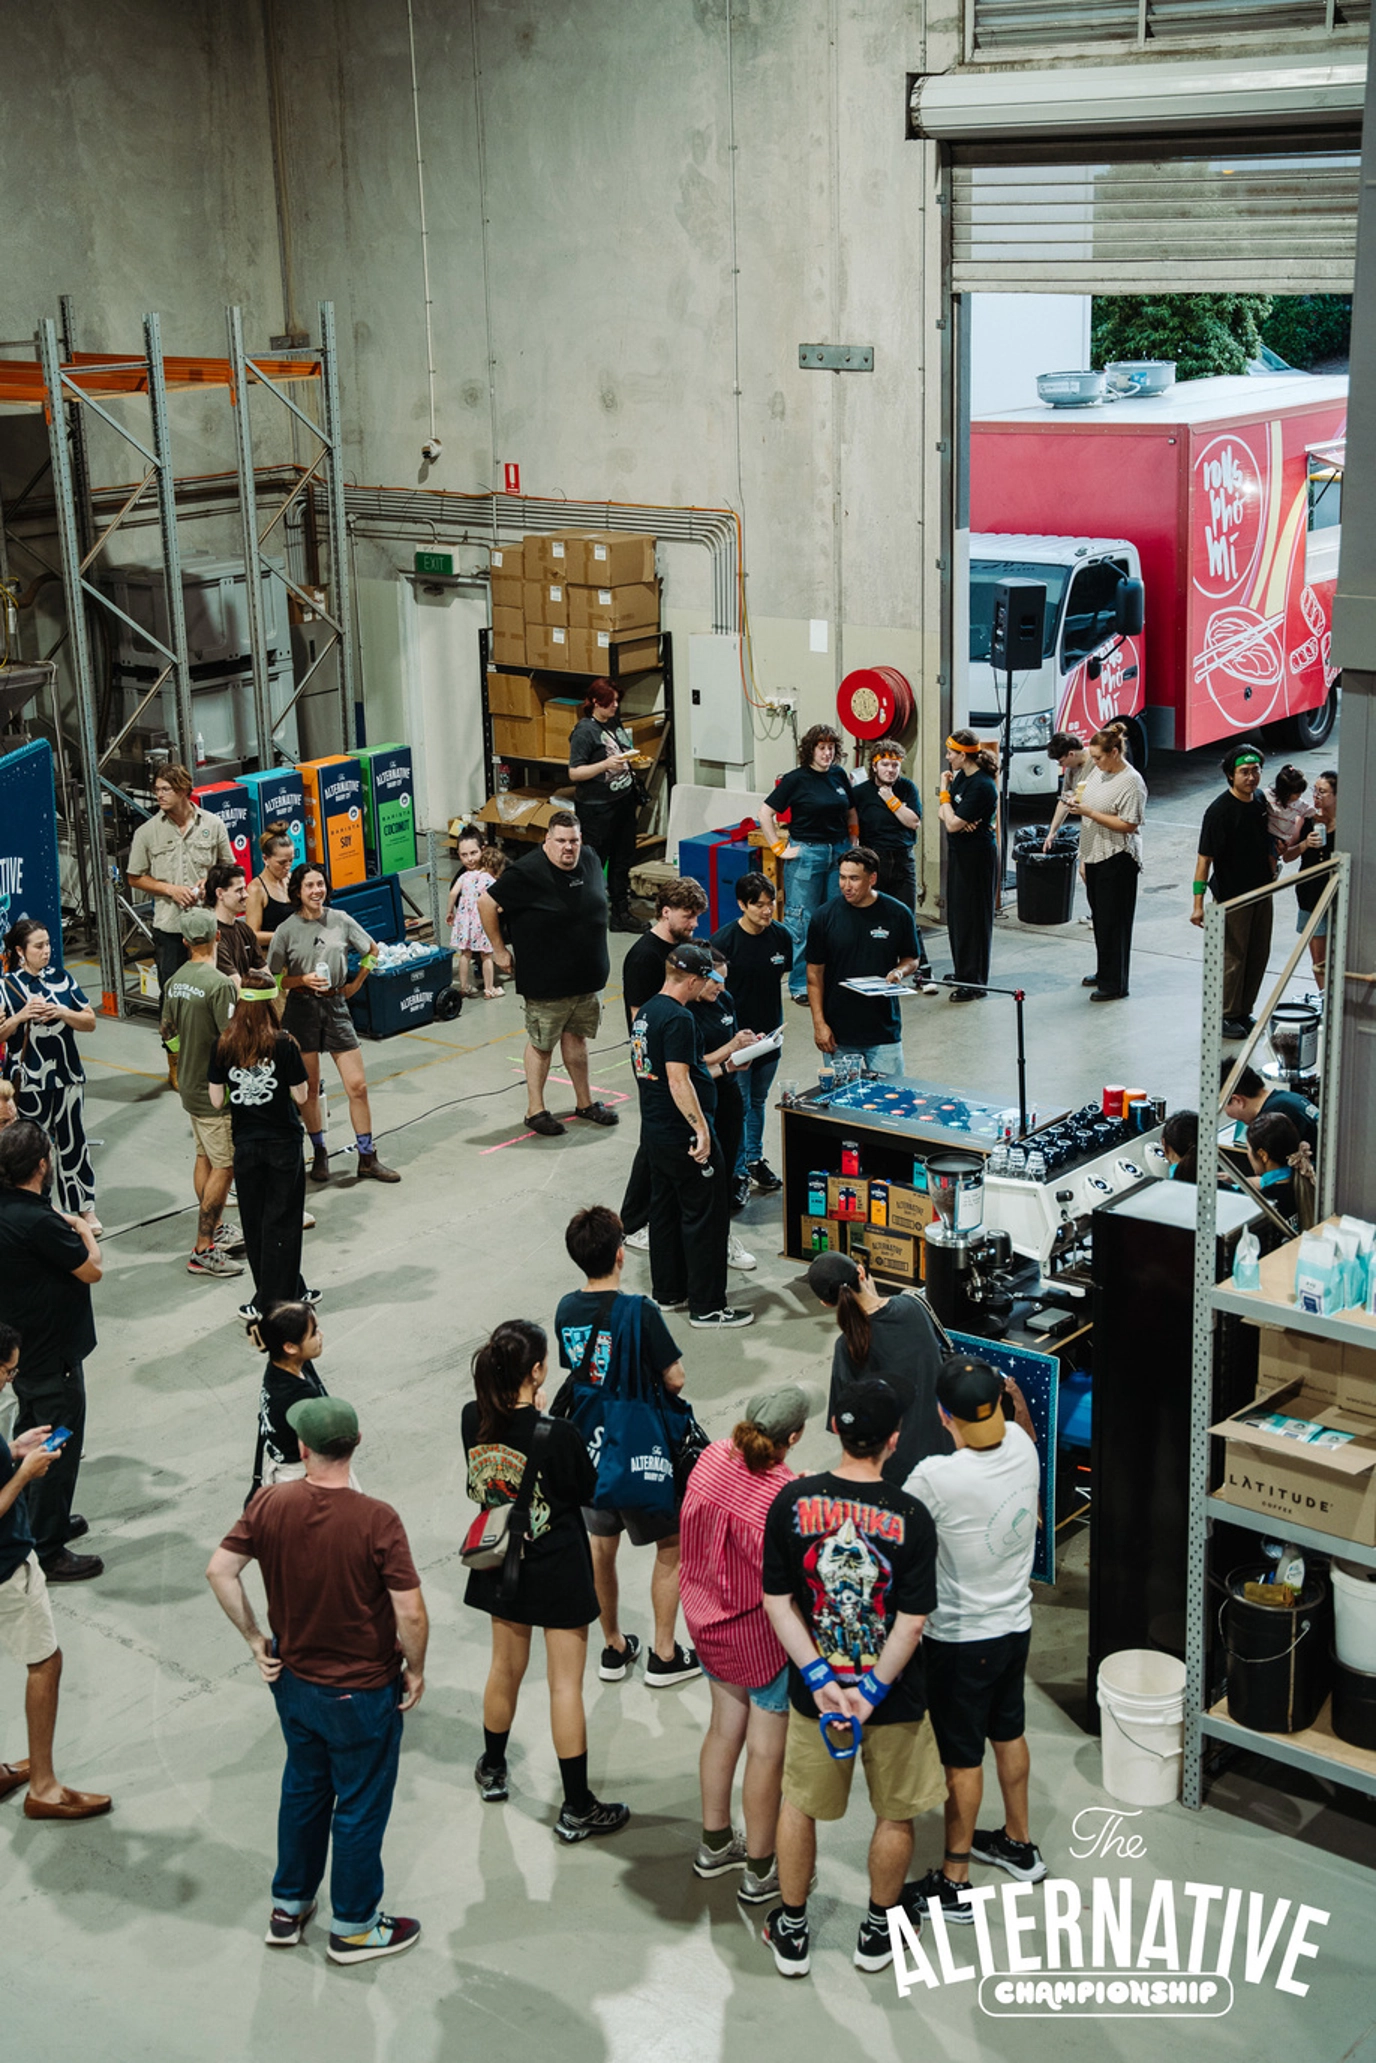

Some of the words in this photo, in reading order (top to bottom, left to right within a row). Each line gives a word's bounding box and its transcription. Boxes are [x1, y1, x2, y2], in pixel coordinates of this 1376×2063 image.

[1203, 445, 1243, 494] rolls
[424, 555, 444, 570] EXIT
[376, 767, 411, 787] ALTERNATIVE
[325, 780, 360, 800] ALTERNATIVE
[264, 793, 303, 813] ALTERNATIVE
[216, 808, 247, 820] ERNATIVE
[382, 810, 411, 822] BARISTA
[330, 823, 360, 836] BARISTA
[340, 835, 352, 848] SOY
[0, 857, 23, 896] TIVE
[1261, 1500, 1293, 1514] COFFEE
